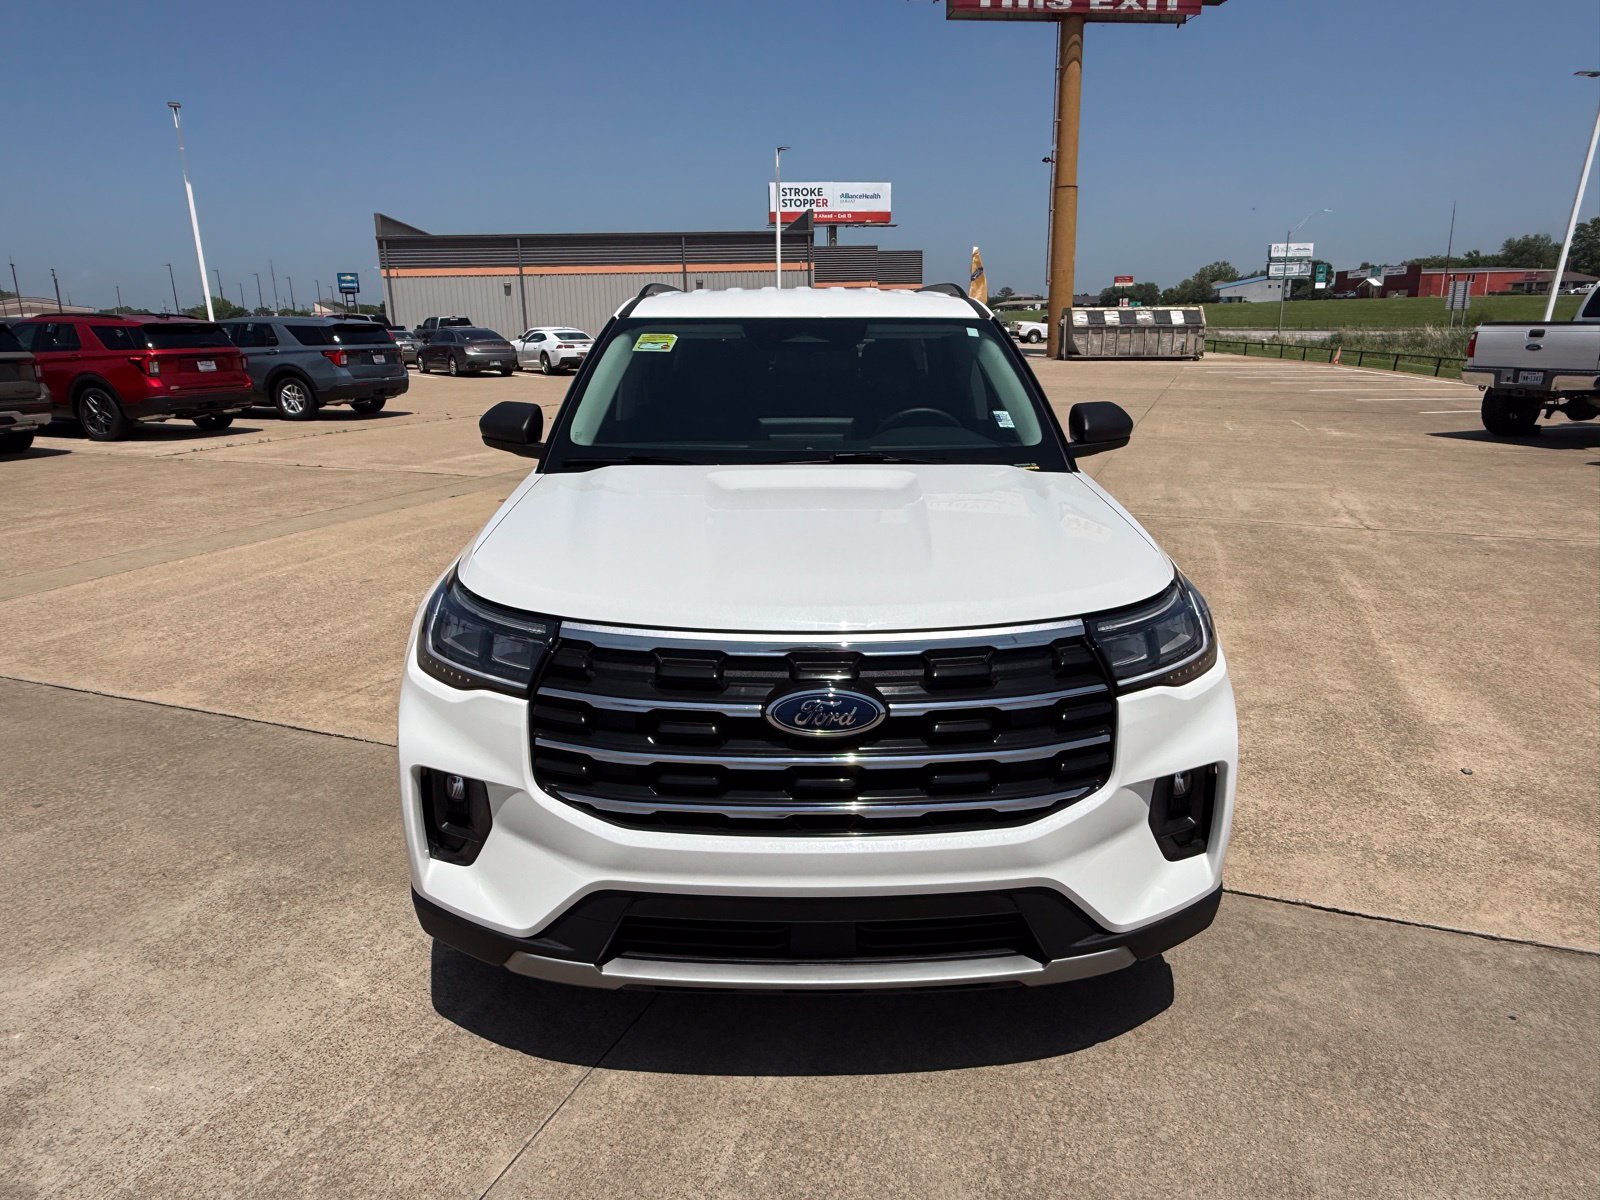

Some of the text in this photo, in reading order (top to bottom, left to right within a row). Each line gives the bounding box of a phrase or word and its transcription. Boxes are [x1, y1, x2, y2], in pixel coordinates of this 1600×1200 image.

[781, 187, 823, 197] STROKE
[781, 198, 829, 207] STOPPER
[794, 699, 858, 726] Ford
